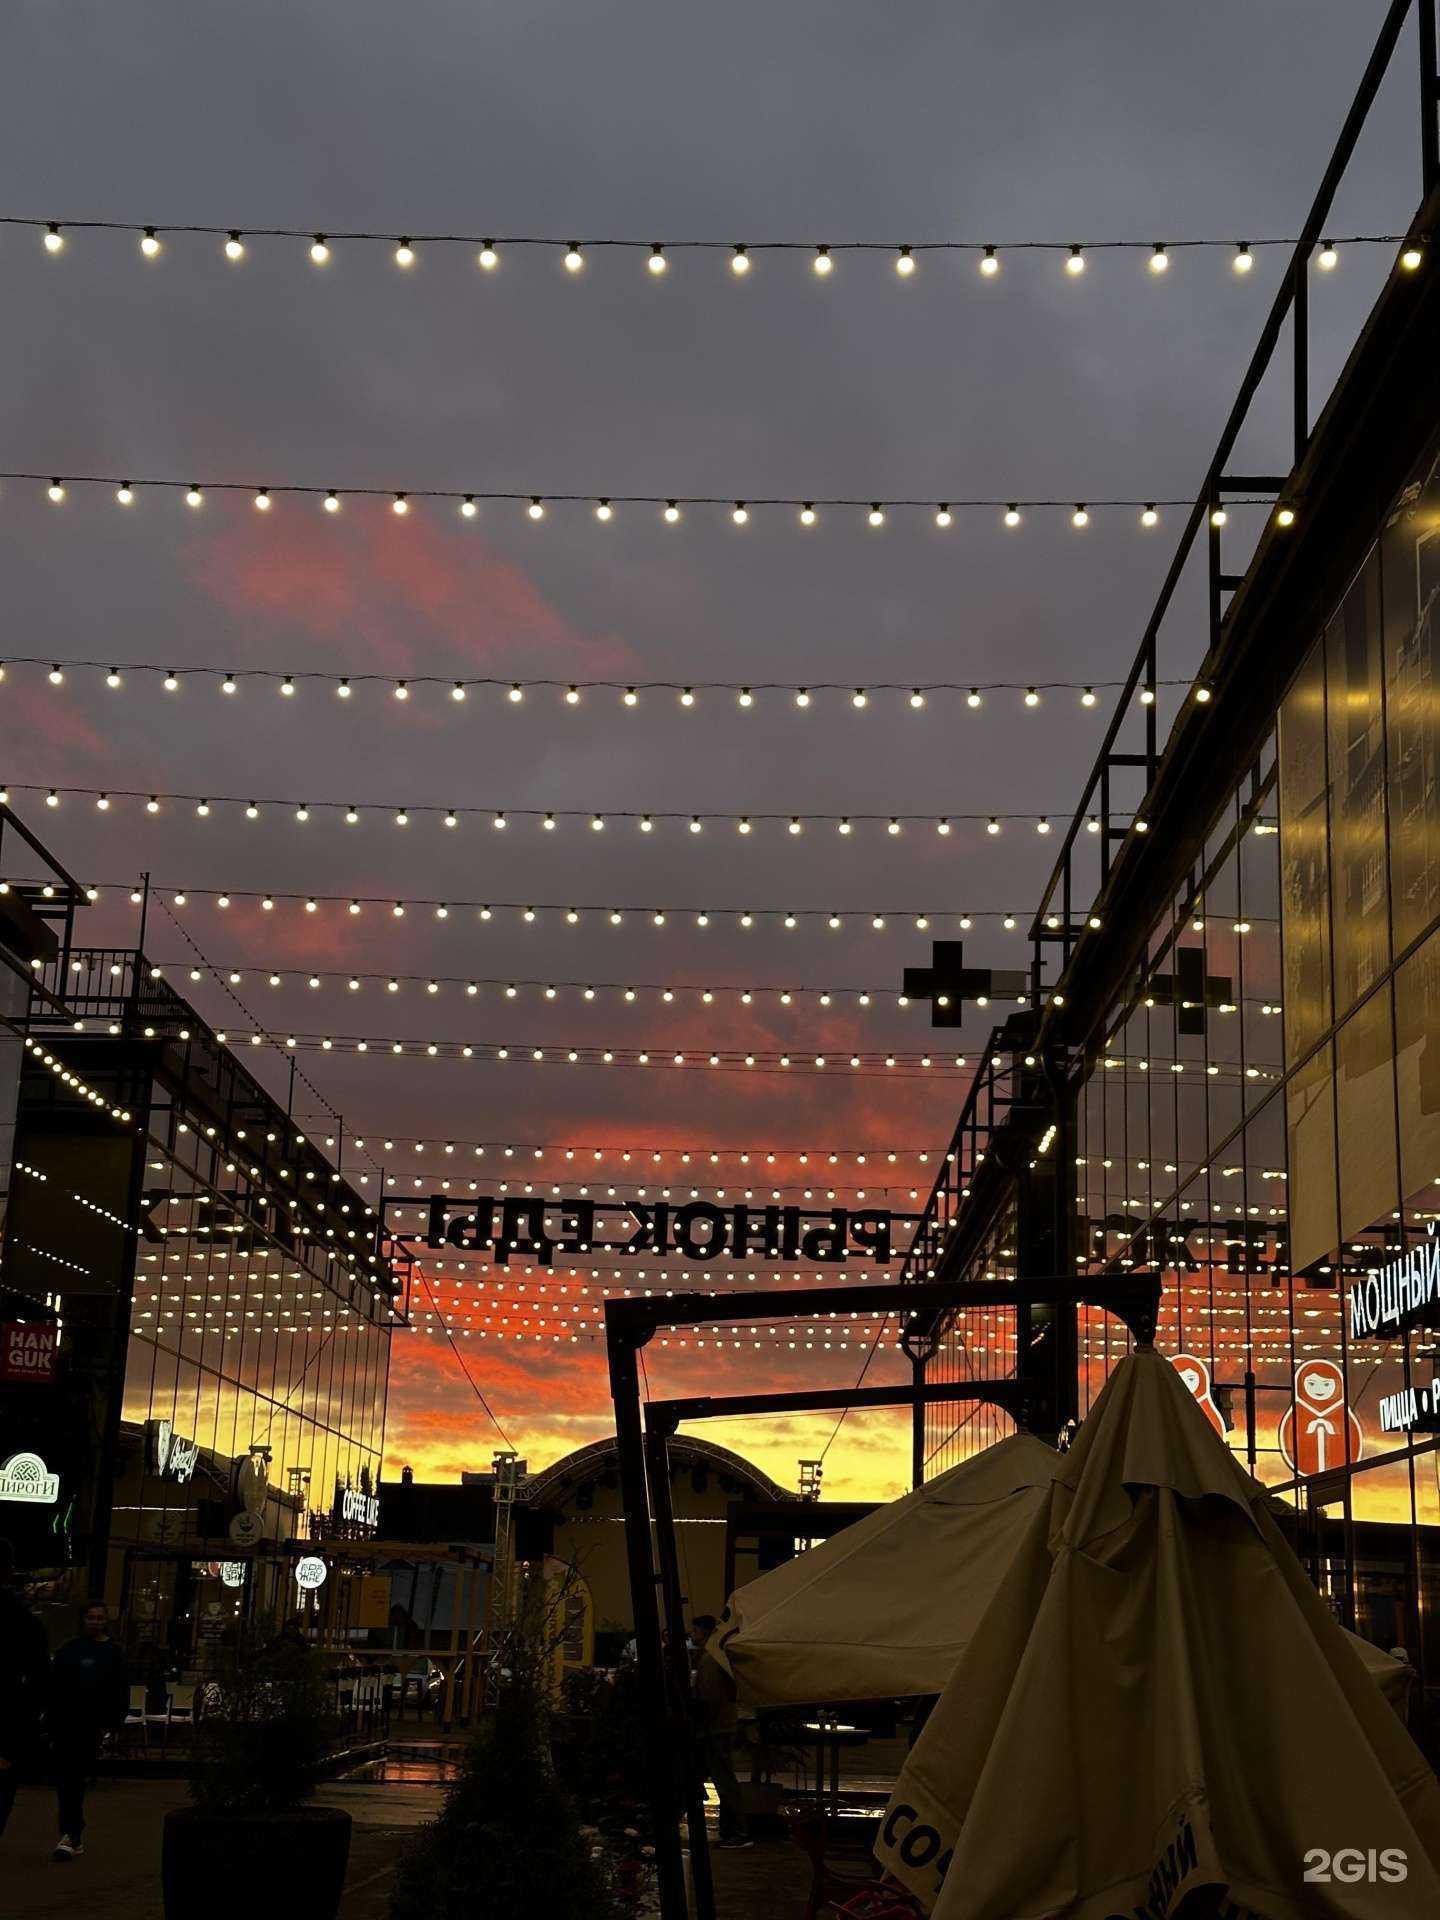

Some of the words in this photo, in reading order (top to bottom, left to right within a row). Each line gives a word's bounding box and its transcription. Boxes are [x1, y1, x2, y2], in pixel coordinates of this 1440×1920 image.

[1350, 1221, 1440, 1340] МОЩНЫЙ
[9, 1331, 54, 1351] HAN
[8, 1349, 53, 1369] GUK
[1379, 1387, 1419, 1432] ПИЦЦА
[342, 1489, 367, 1523] COFFEE
